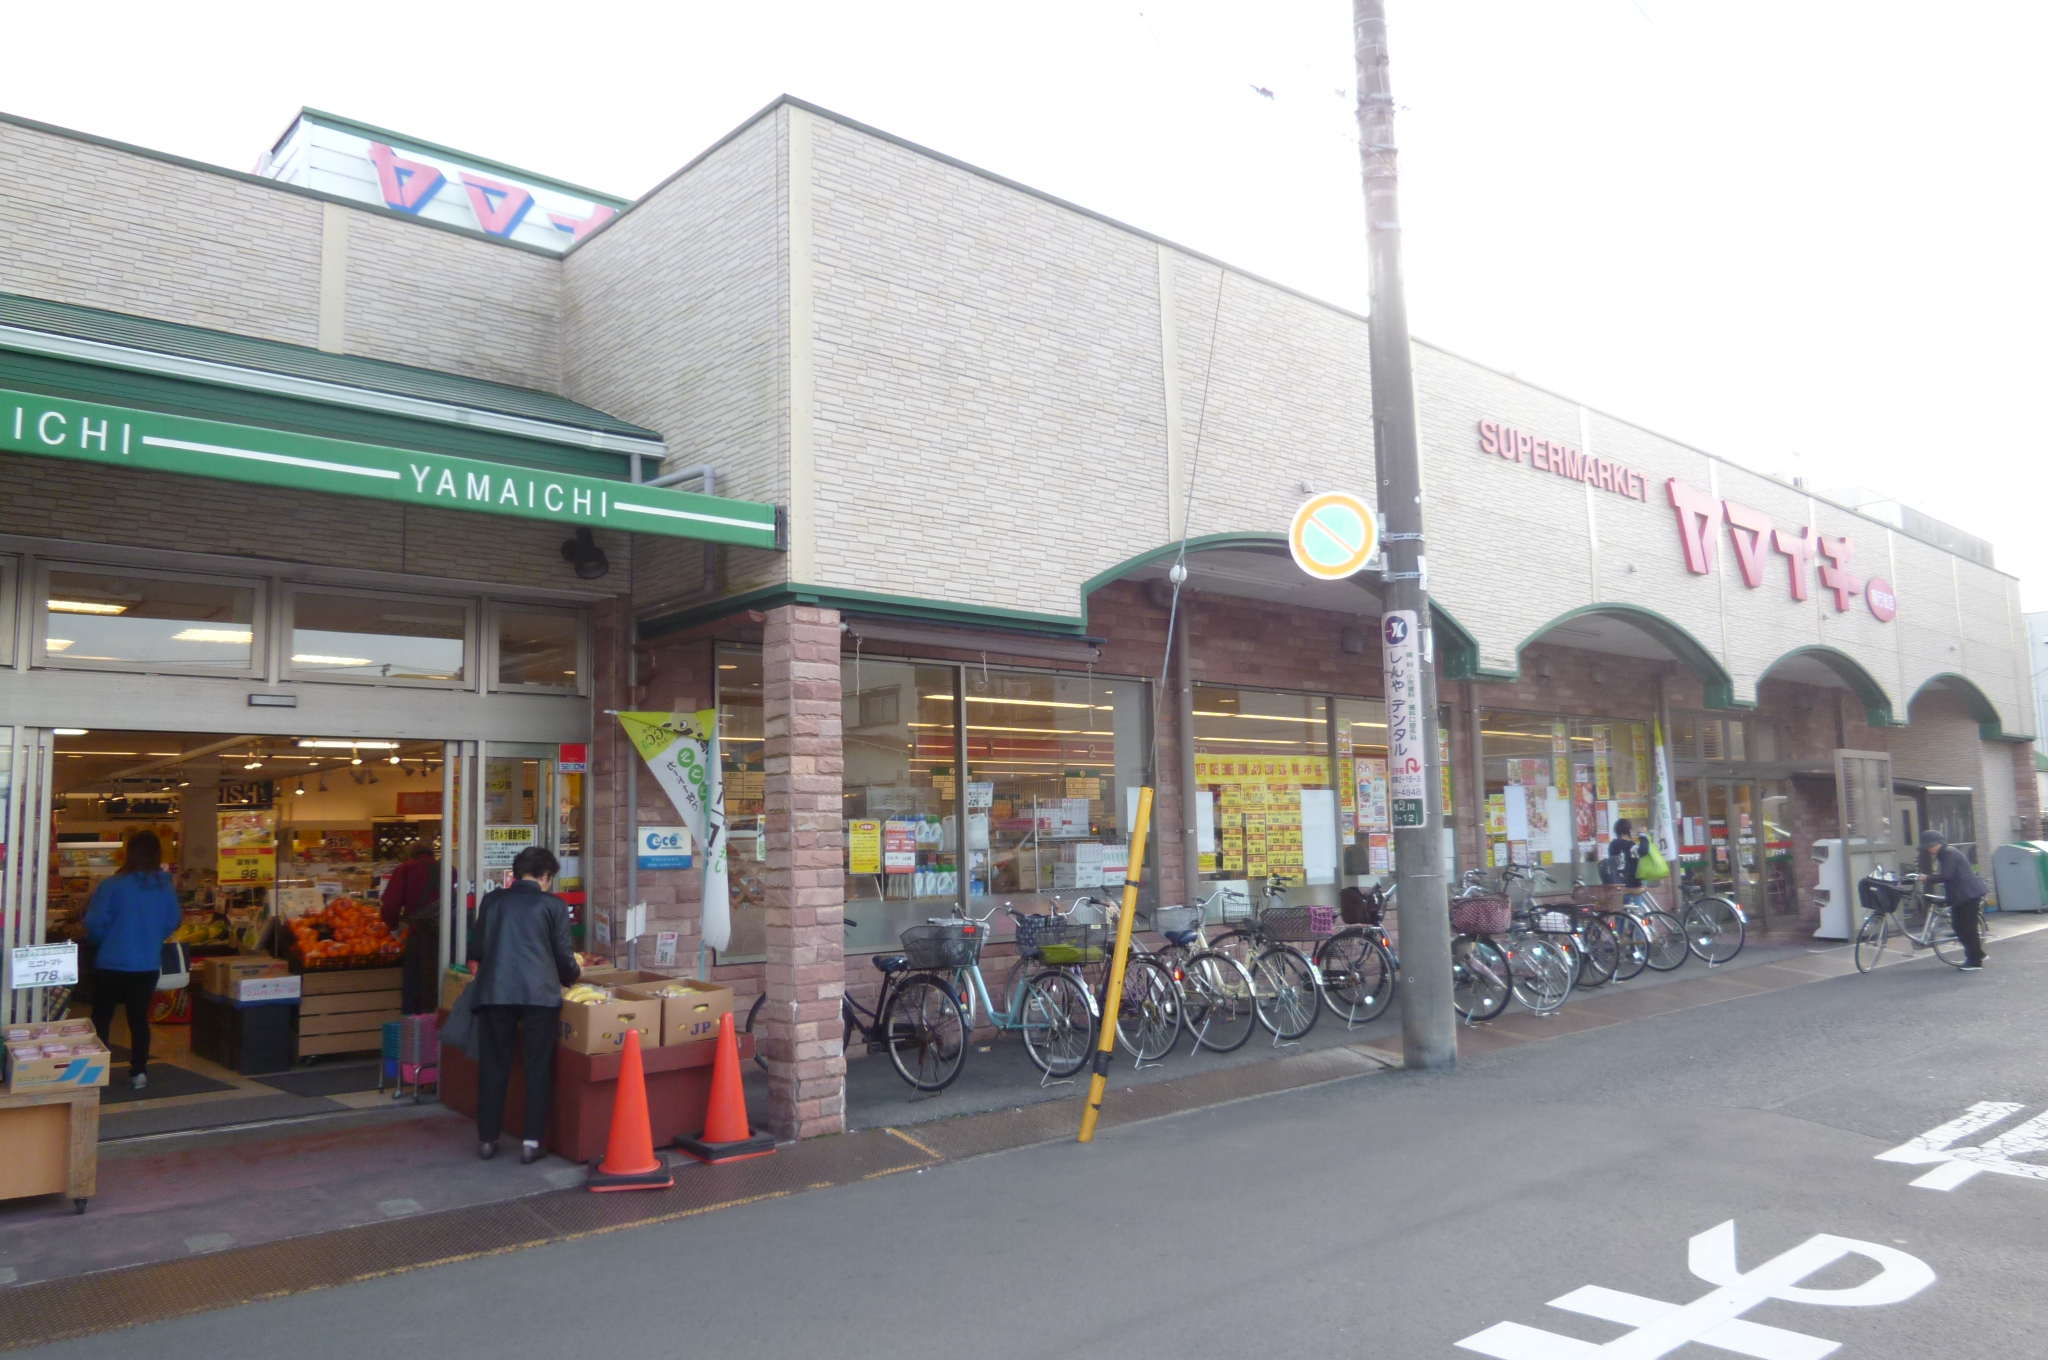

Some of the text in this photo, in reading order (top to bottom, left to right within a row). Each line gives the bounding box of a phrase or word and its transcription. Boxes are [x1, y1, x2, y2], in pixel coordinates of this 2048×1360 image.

[1478, 418, 1651, 502] SUPERMARKET
[409, 463, 608, 518] YAMAICHI
[1664, 476, 1861, 612] ヤマイチ
[1390, 651, 1404, 692] しんや
[1391, 699, 1408, 756] デンタル
[28, 958, 63, 968] ミニトマト
[34, 970, 59, 982] 178
[690, 1021, 711, 1035] JP
